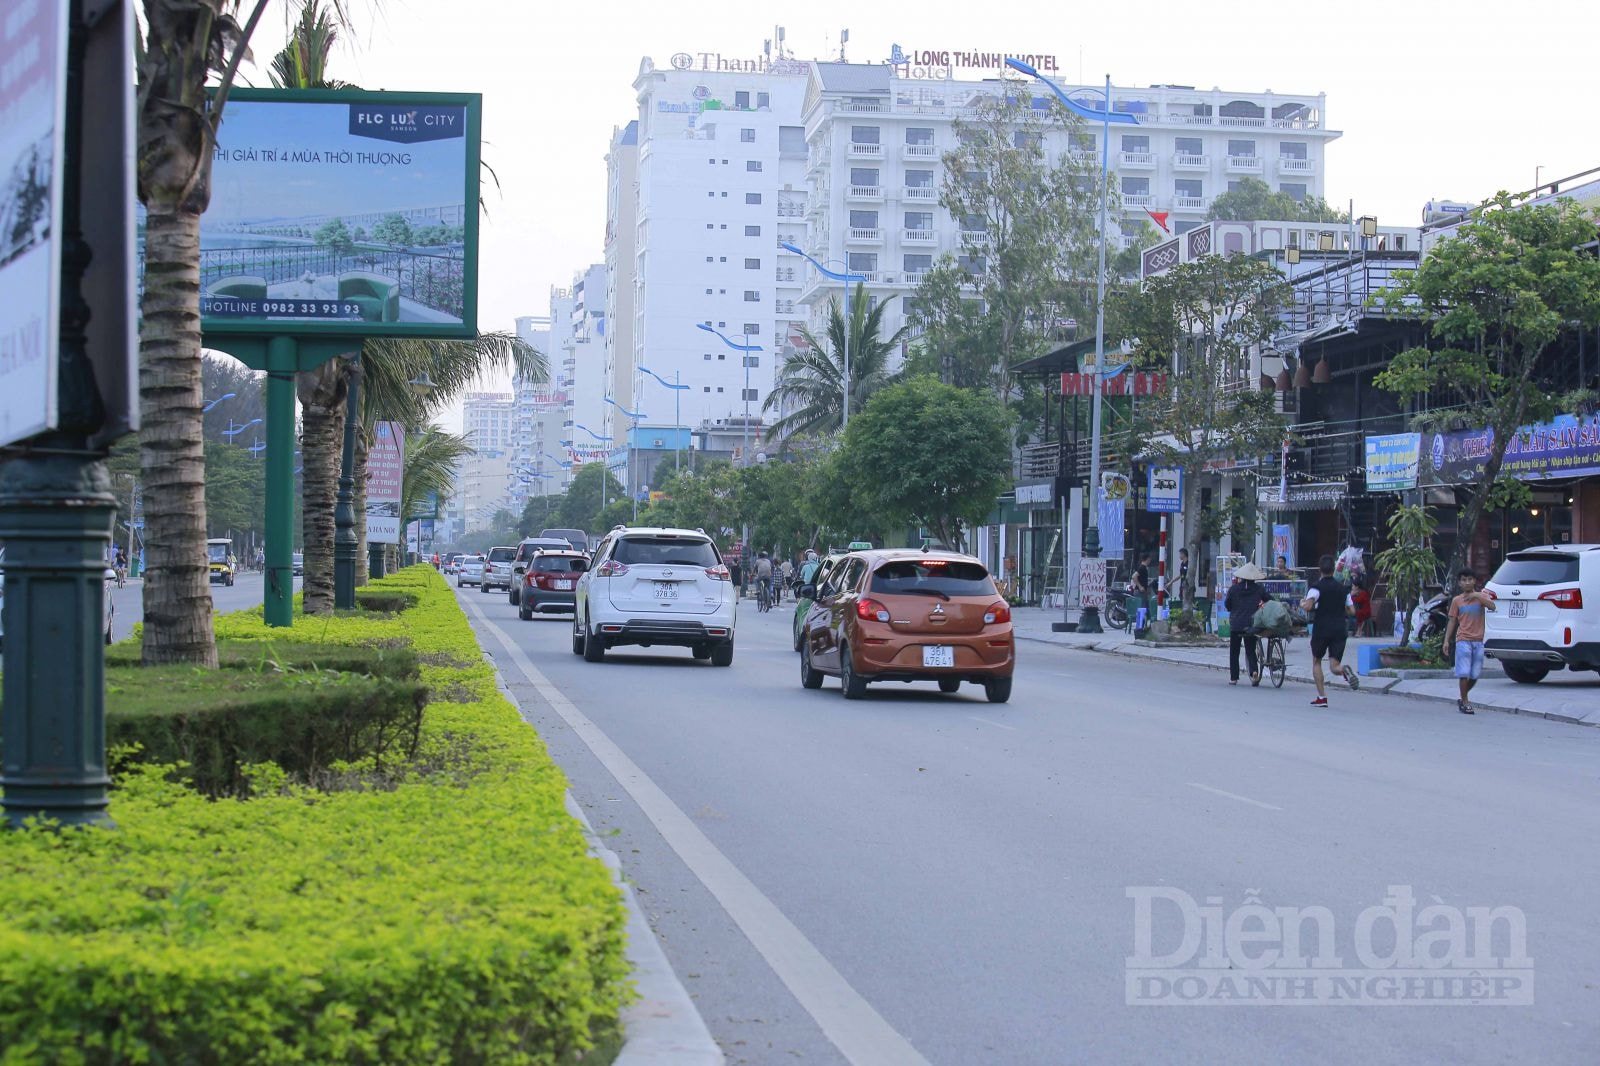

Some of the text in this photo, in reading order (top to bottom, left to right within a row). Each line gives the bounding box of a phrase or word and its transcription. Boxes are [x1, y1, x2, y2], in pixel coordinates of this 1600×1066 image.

[914, 50, 949, 67] LONG
[953, 48, 1000, 69] THÀNH
[358, 111, 456, 126] FLC LUX CITY
[232, 147, 258, 162] GIẢI
[261, 148, 277, 162] TRÍ
[281, 152, 288, 163] 4
[291, 149, 321, 163] MÙA
[324, 149, 353, 164] THỜI
[357, 152, 412, 166] THƯỢNG
[204, 302, 360, 314] HOTLINE 0982 33 93 93
